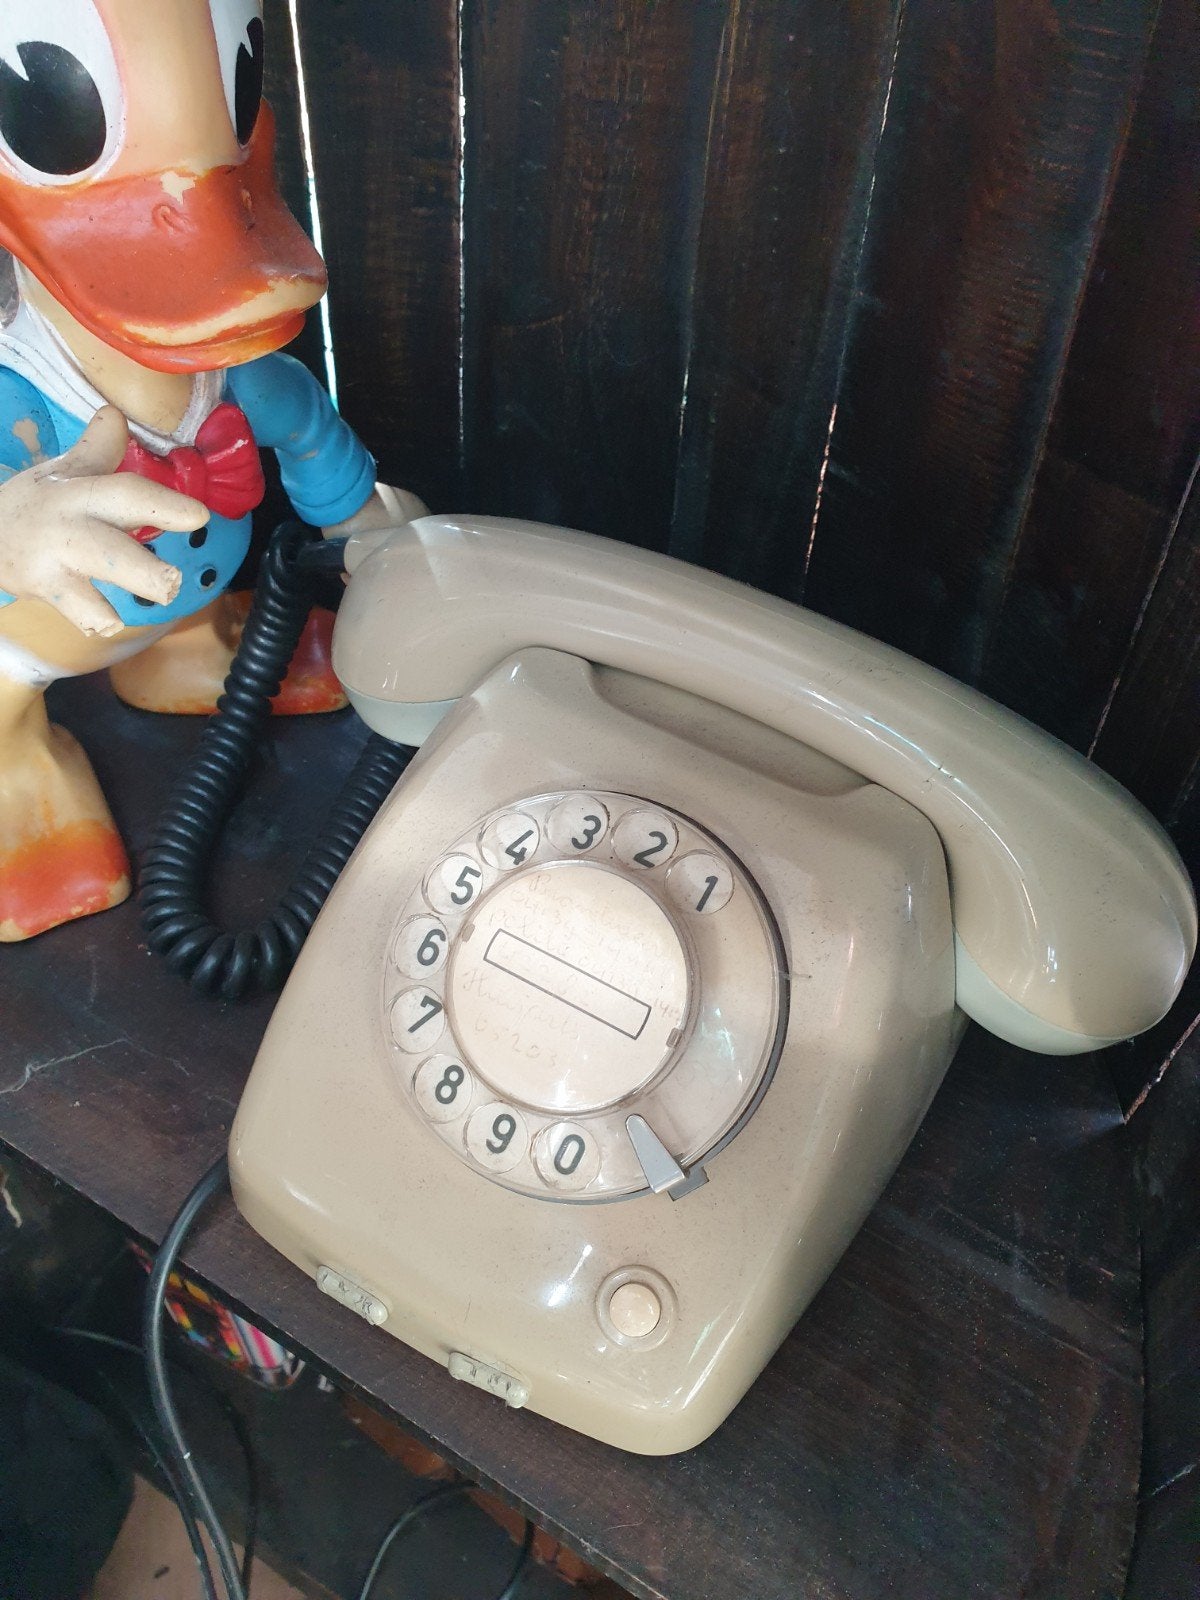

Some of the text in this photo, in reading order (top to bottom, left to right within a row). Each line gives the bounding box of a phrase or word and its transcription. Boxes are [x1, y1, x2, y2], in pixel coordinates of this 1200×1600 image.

[504, 829, 535, 866] 4
[571, 815, 602, 850] 3
[633, 831, 668, 868] 2
[450, 865, 482, 905] 5
[695, 875, 719, 912] 1
[416, 928, 446, 966] 6
[407, 995, 443, 1033] 7
[435, 1064, 465, 1105] 8
[486, 1114, 517, 1154] 9
[553, 1134, 586, 1175] 0
